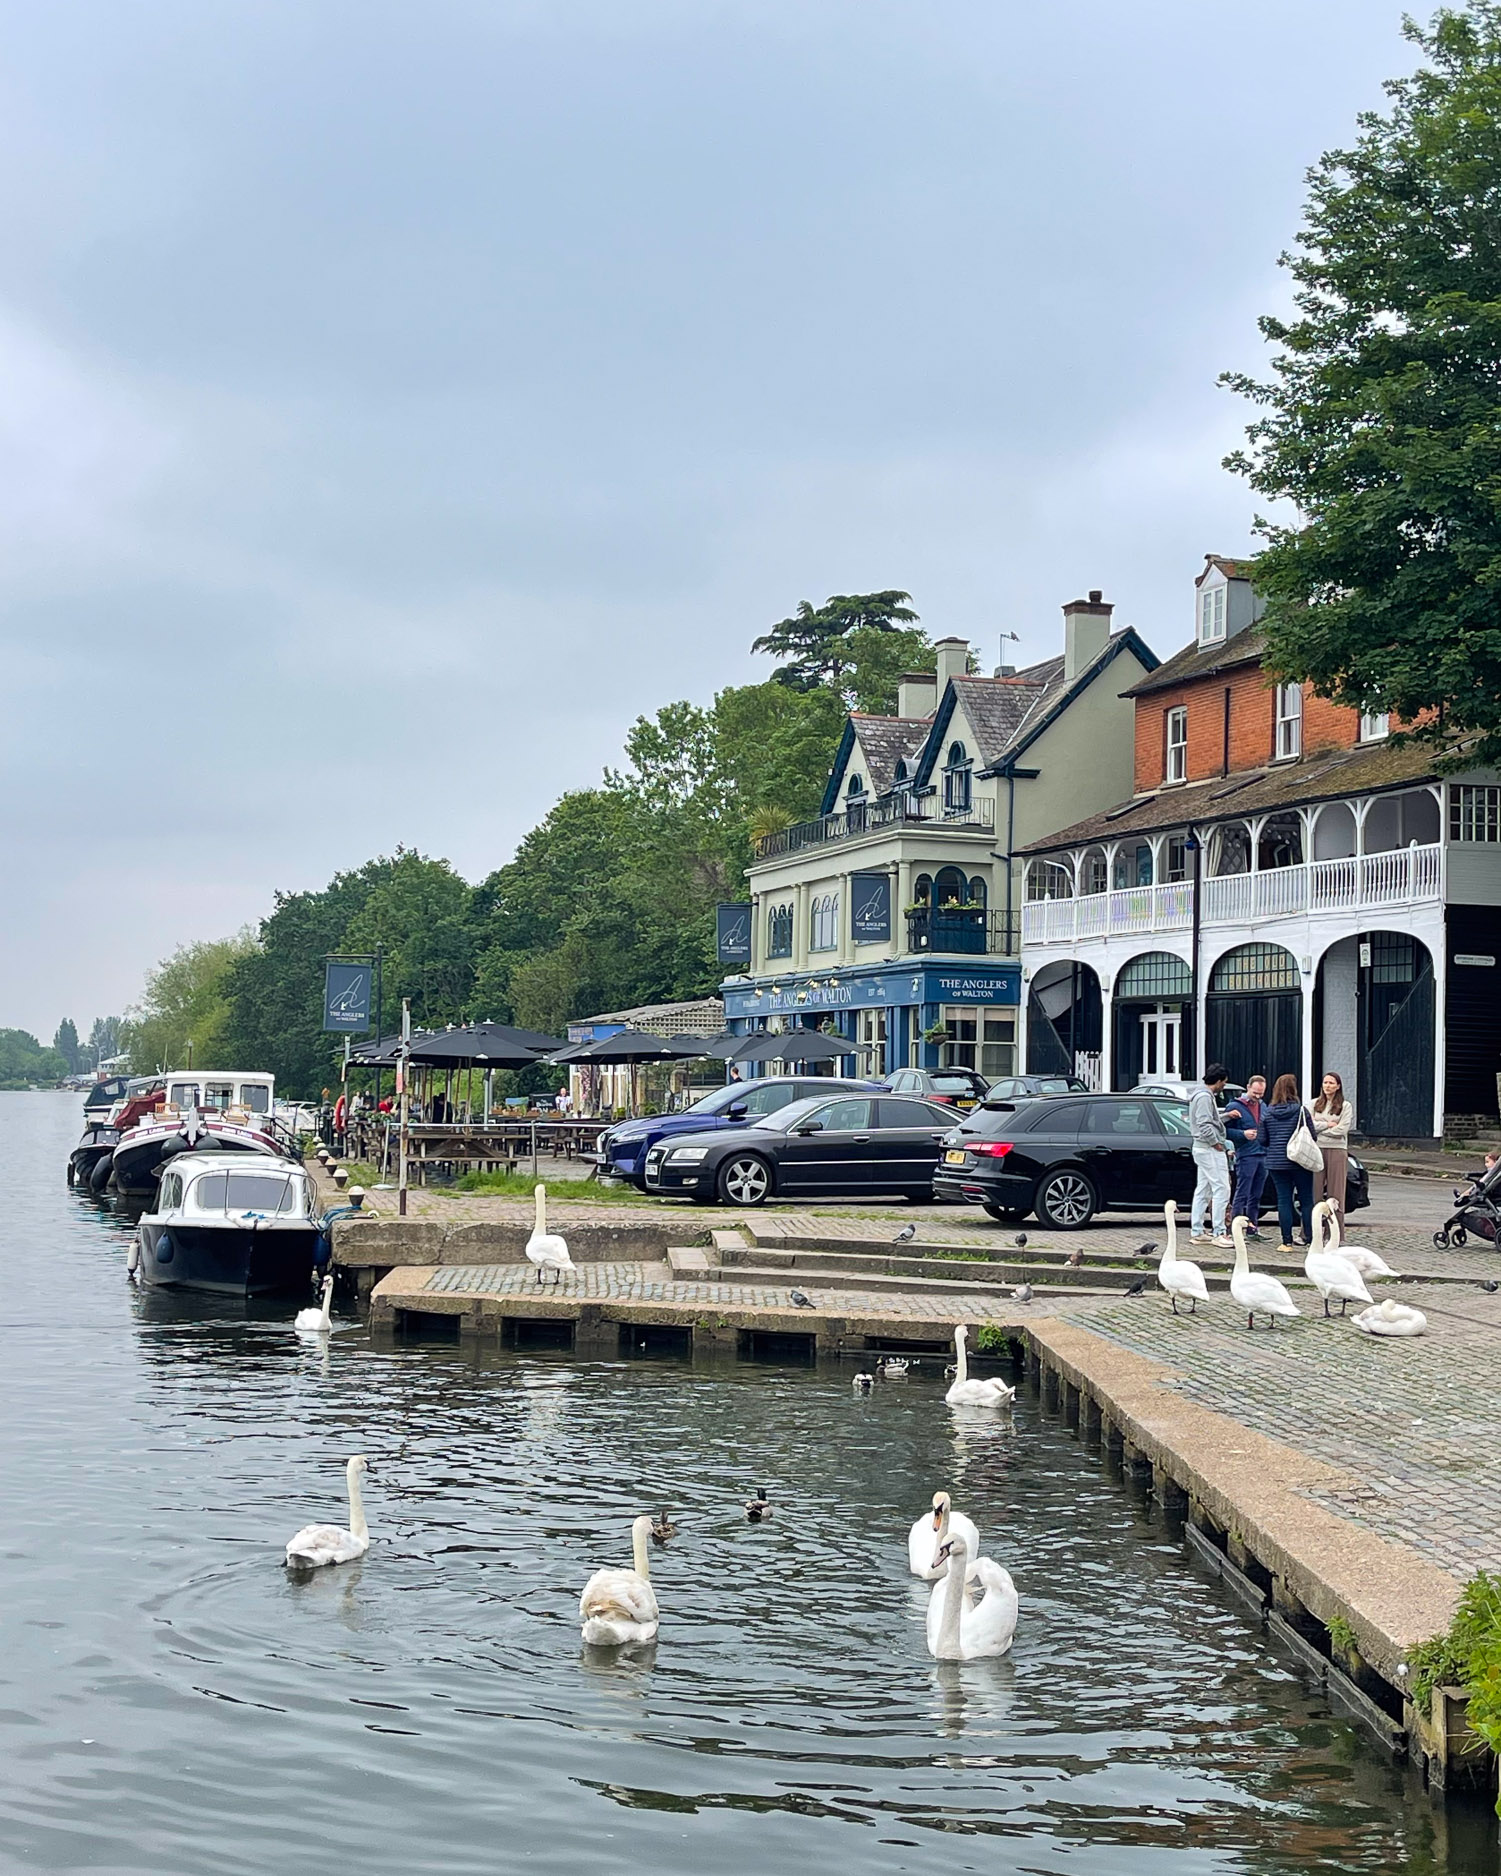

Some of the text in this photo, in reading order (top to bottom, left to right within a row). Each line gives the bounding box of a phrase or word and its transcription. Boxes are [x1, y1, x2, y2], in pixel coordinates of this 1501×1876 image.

[939, 979, 1007, 989] THE ANGLERS
[768, 994, 782, 1009] THE
[783, 989, 812, 1008] ANGLRS
[821, 986, 852, 1005] WALTON
[961, 990, 994, 998] WALTON
